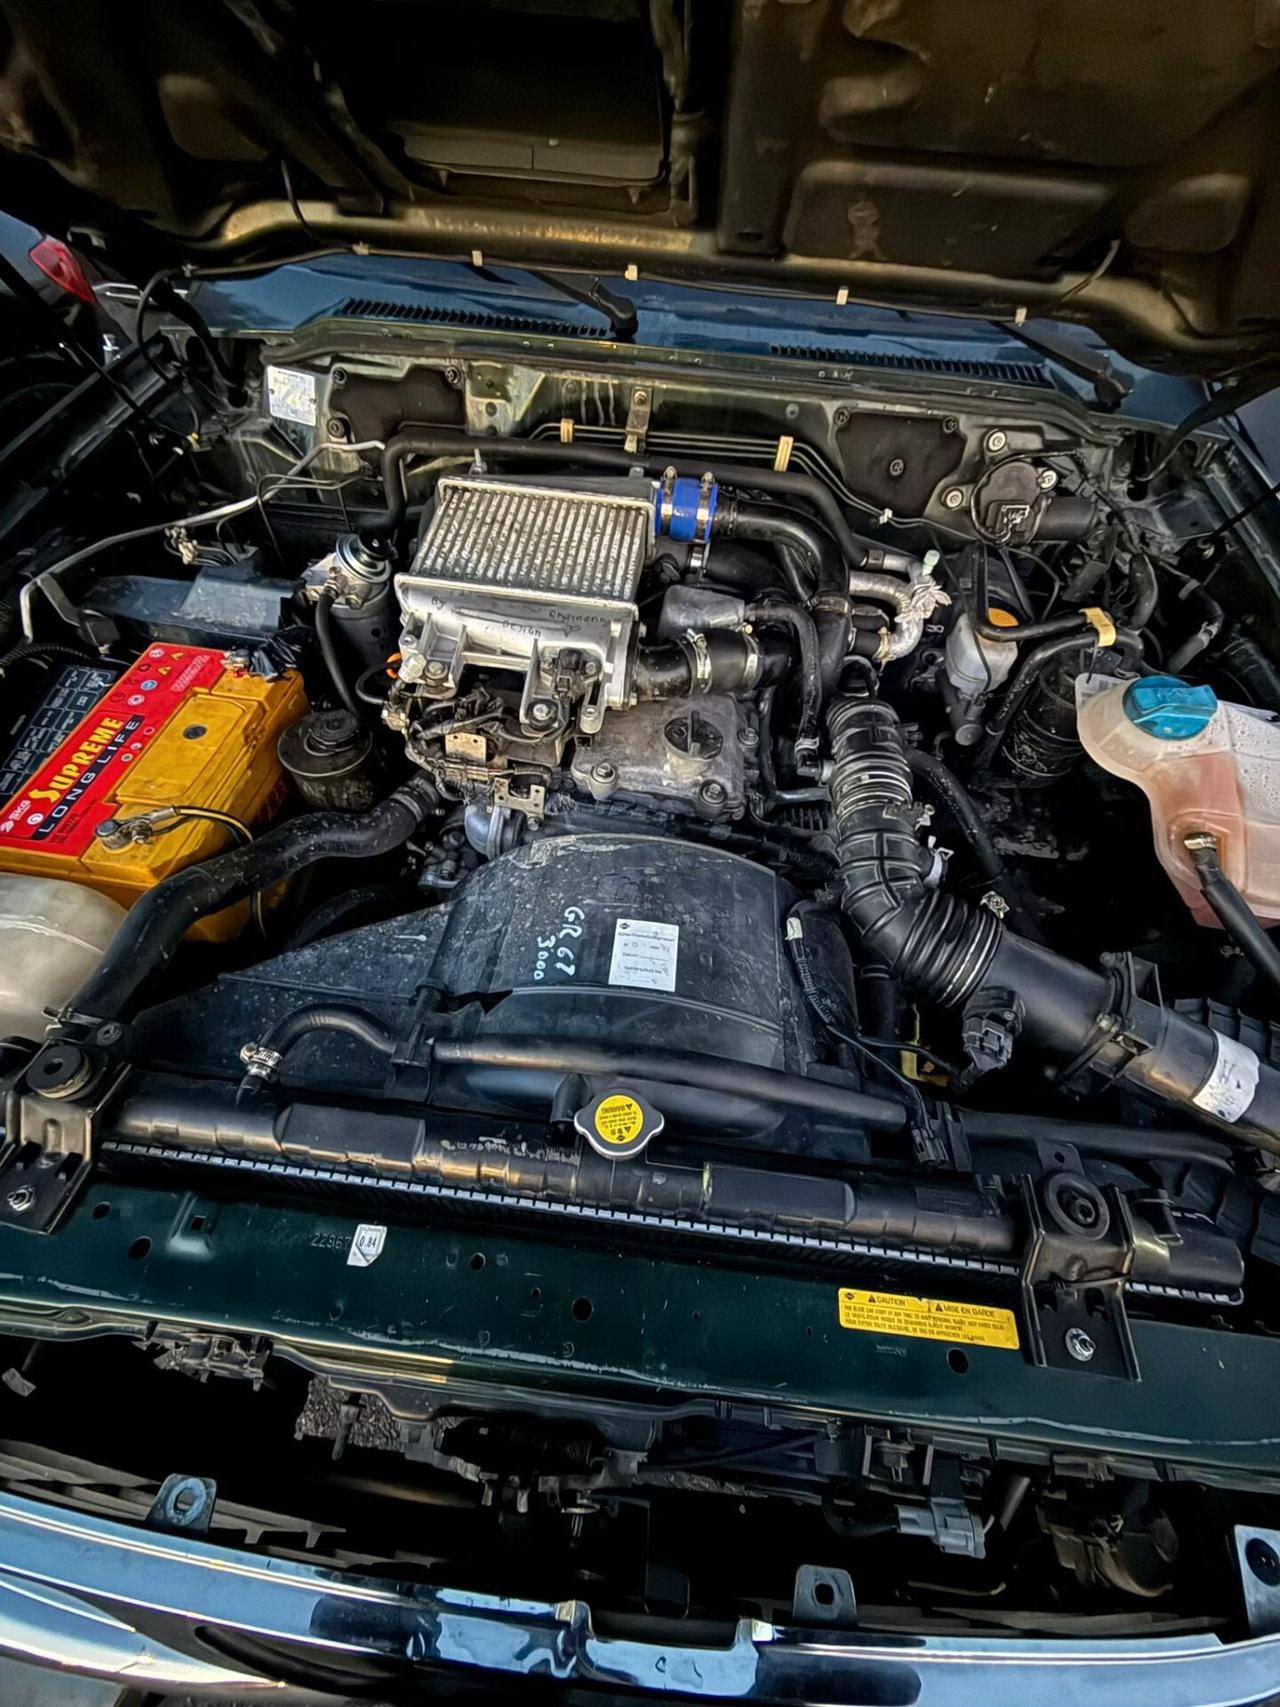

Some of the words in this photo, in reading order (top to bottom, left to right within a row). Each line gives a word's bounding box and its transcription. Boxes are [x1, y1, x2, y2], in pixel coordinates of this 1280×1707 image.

[38, 772, 96, 833] LONG
[97, 720, 140, 764] LIFE
[876, 1296, 906, 1307] CAUTION
